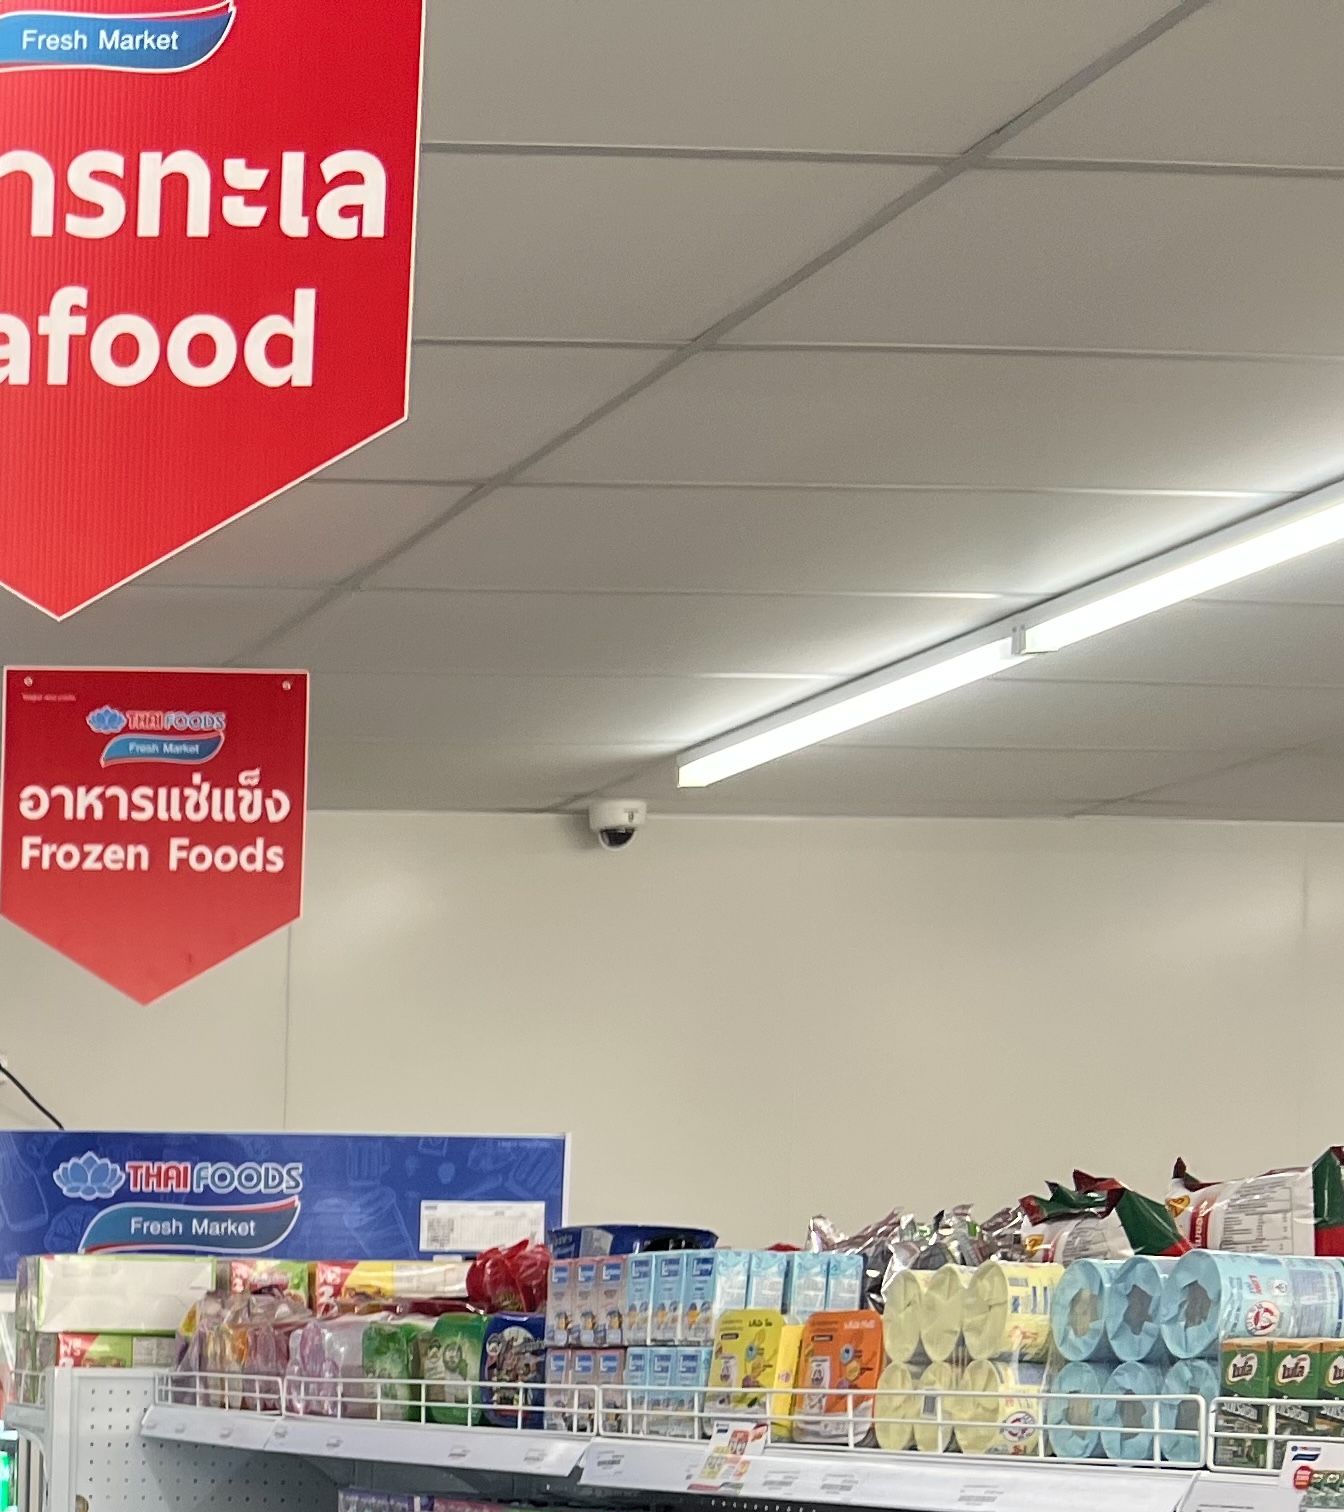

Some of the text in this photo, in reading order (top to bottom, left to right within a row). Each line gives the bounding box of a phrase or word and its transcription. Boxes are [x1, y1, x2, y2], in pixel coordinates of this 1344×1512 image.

[21, 28, 179, 53] Fresh Market
[126, 709, 226, 733] THAI FOODS
[128, 742, 201, 756] Fresh Market
[19, 768, 291, 826] อาหารแช่แข็ง
[20, 836, 285, 875] Frozen Foods
[125, 1161, 303, 1195] THAI FOODS
[129, 1216, 257, 1239] Fresh Market
